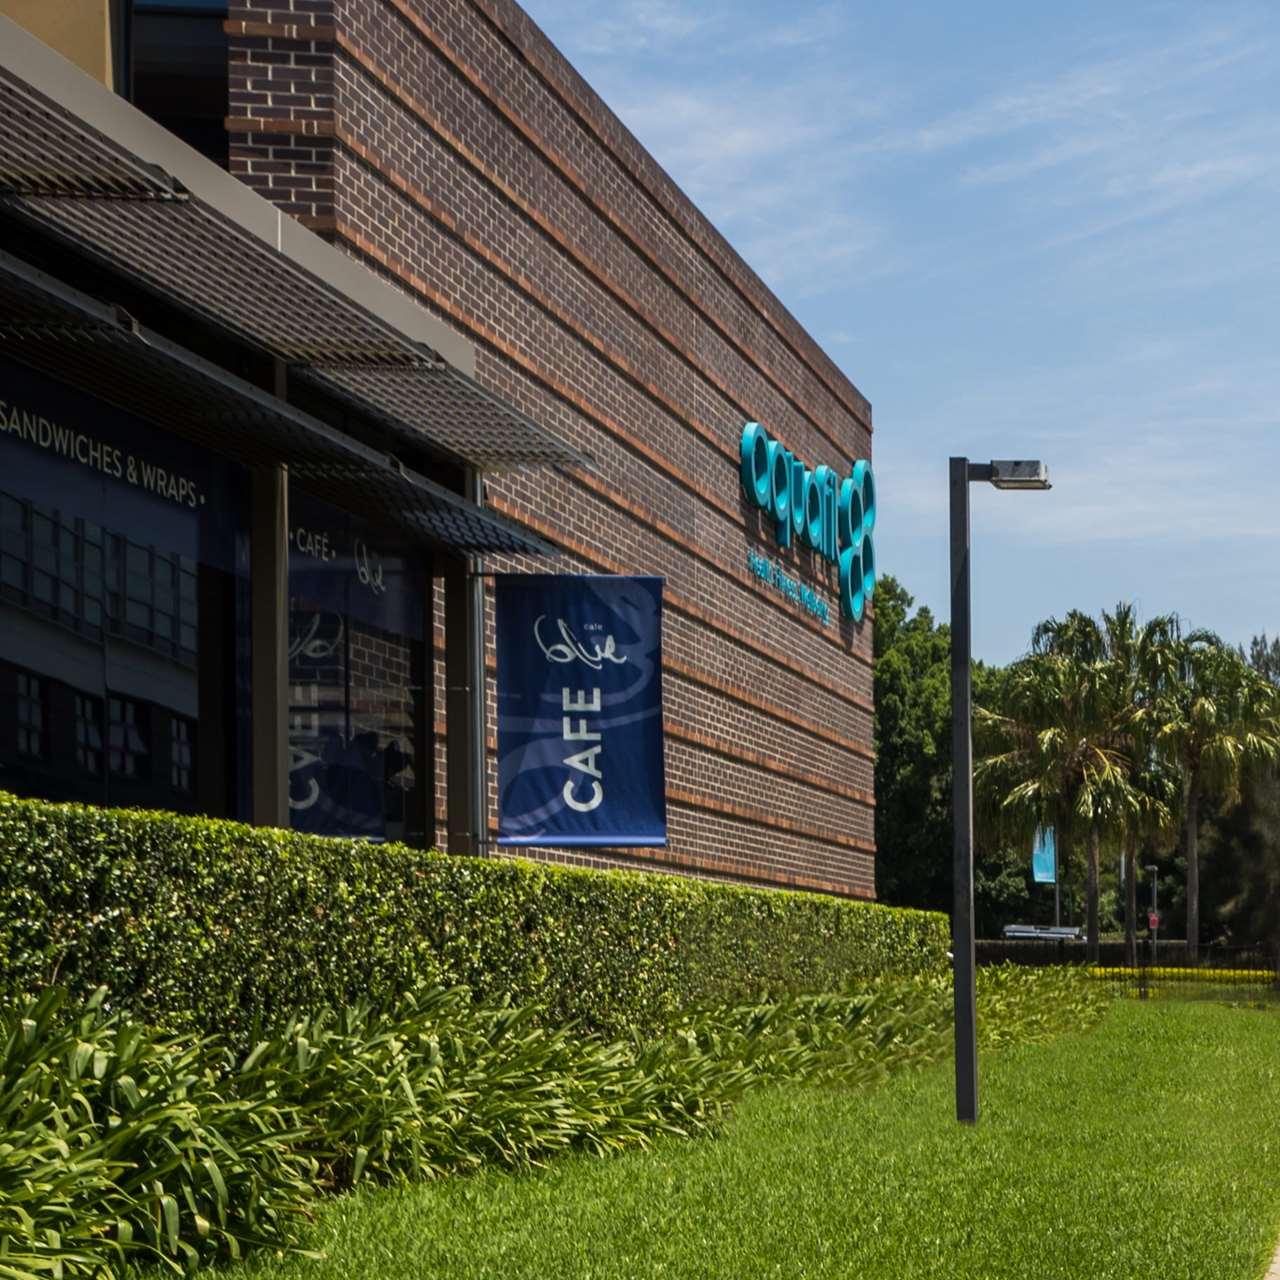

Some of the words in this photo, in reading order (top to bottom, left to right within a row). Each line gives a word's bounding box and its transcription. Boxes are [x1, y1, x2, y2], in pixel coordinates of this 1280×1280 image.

[0, 400, 123, 479] SANDWICHES
[126, 455, 139, 485] &
[140, 461, 198, 508] WRAPS
[562, 687, 604, 813] CAFE
